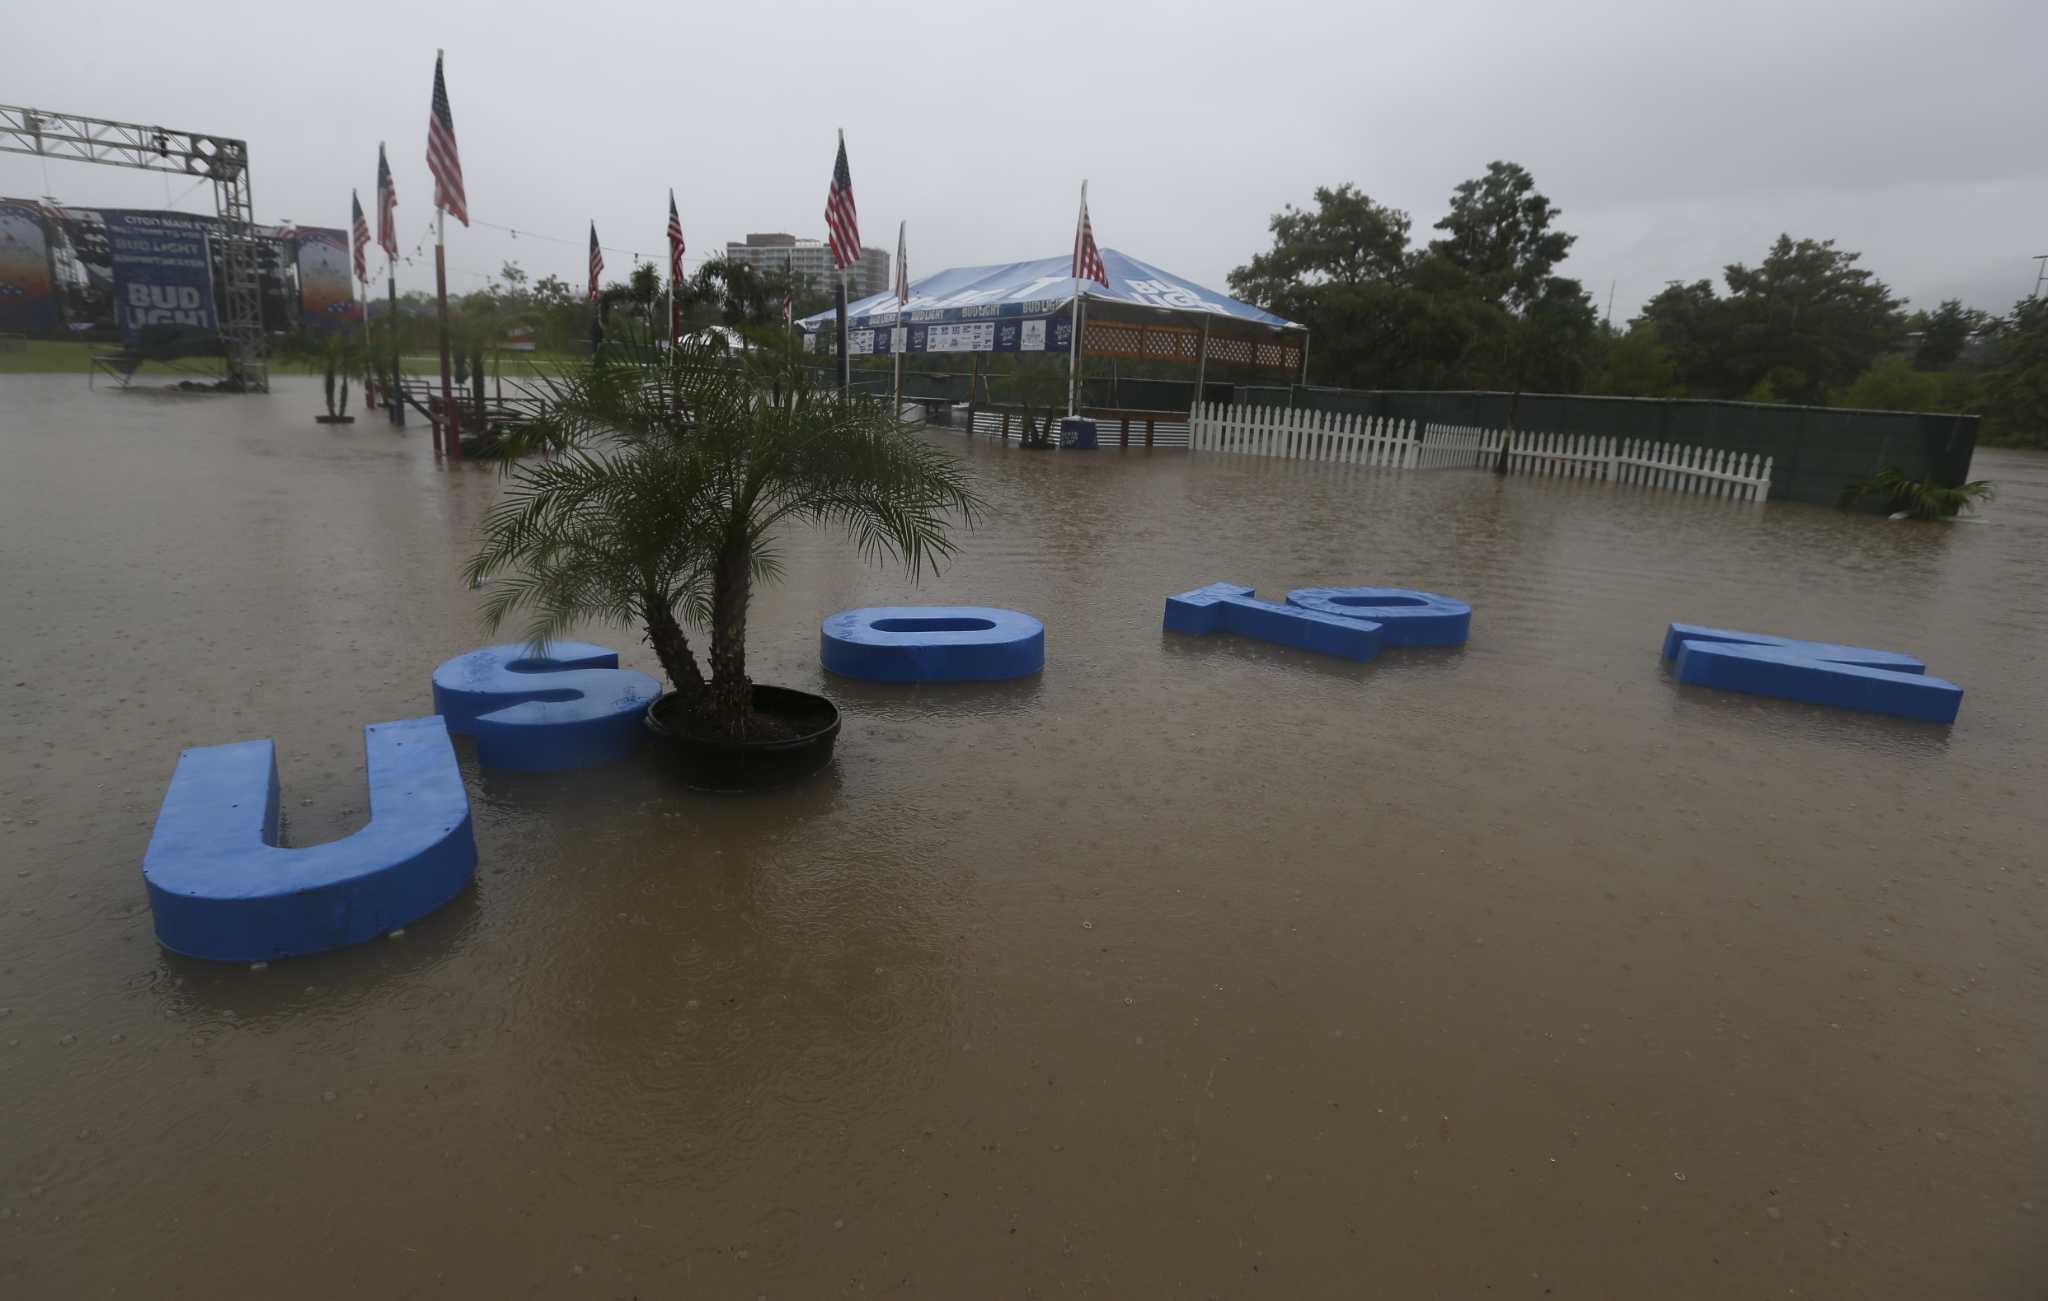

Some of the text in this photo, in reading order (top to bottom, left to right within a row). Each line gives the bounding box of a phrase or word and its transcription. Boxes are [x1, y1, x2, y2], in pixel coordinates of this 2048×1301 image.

[123, 215, 160, 226] CITGO
[161, 219, 193, 230] MAIN
[153, 241, 200, 255] LIGHT
[127, 283, 201, 309] BUD
[926, 309, 945, 320] LIGHT
[979, 304, 1000, 317] LIGHT
[433, 641, 662, 773] S
[143, 715, 478, 962] U
